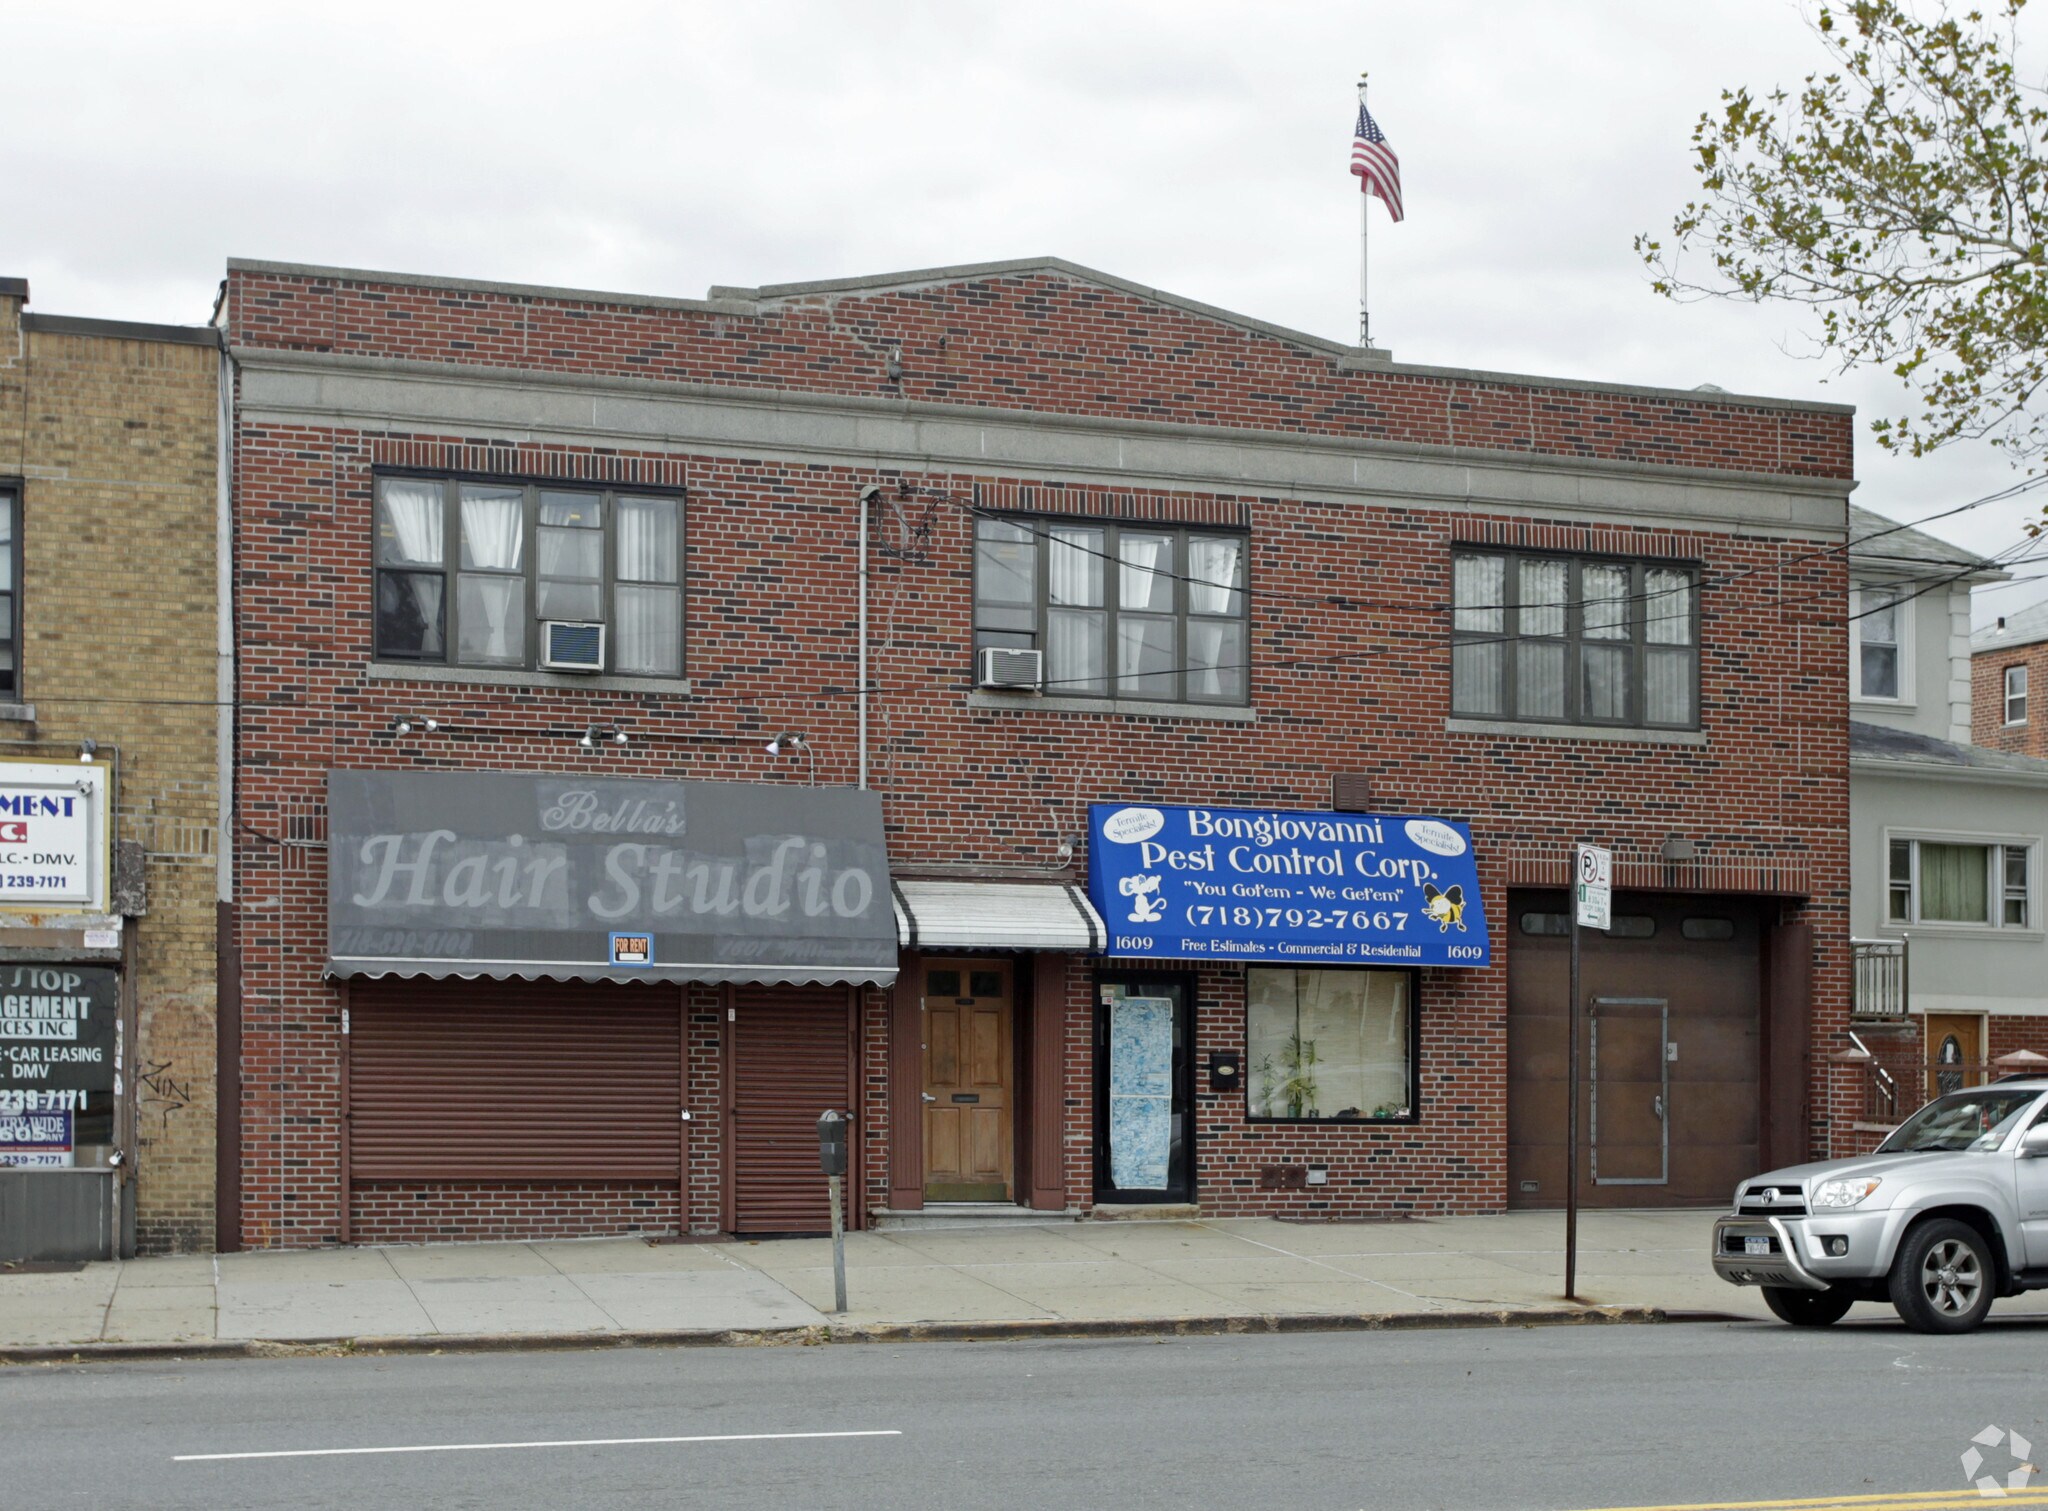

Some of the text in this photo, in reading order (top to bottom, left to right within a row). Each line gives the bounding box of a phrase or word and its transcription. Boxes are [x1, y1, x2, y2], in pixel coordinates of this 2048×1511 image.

[0, 795, 76, 817] MENT
[543, 790, 685, 834] Bella's
[1113, 819, 1157, 839] Specialists!
[1115, 812, 1148, 828] Termite
[1188, 810, 1383, 847] Bongiovanni
[1414, 832, 1460, 853] Specialists!
[1421, 824, 1454, 842] Termite
[353, 829, 873, 918] Hair Studio
[1141, 842, 1438, 887] Pest Control Corp.
[7, 875, 66, 888] 239-7171
[1184, 881, 1226, 896] "You
[1232, 883, 1291, 898] Got'em
[1309, 885, 1336, 899] We
[1342, 887, 1404, 902] Get'em"
[1186, 904, 1409, 931] (718)792-7667
[615, 938, 647, 953] FOR RENT
[1116, 936, 1153, 950] 1609
[1181, 938, 1207, 952] Free
[1210, 939, 1265, 953] Estimates
[1278, 942, 1343, 955] Commercial
[1346, 943, 1358, 955] &
[1361, 943, 1421, 958] Residential
[1448, 945, 1482, 960] 1609
[11, 967, 81, 993] STOP
[0, 995, 91, 1019] GEMENT
[39, 1021, 73, 1036] INC.
[44, 1047, 102, 1062] LEASING
[12, 1064, 49, 1078] DMV
[0, 1089, 87, 1110] 239-7171
